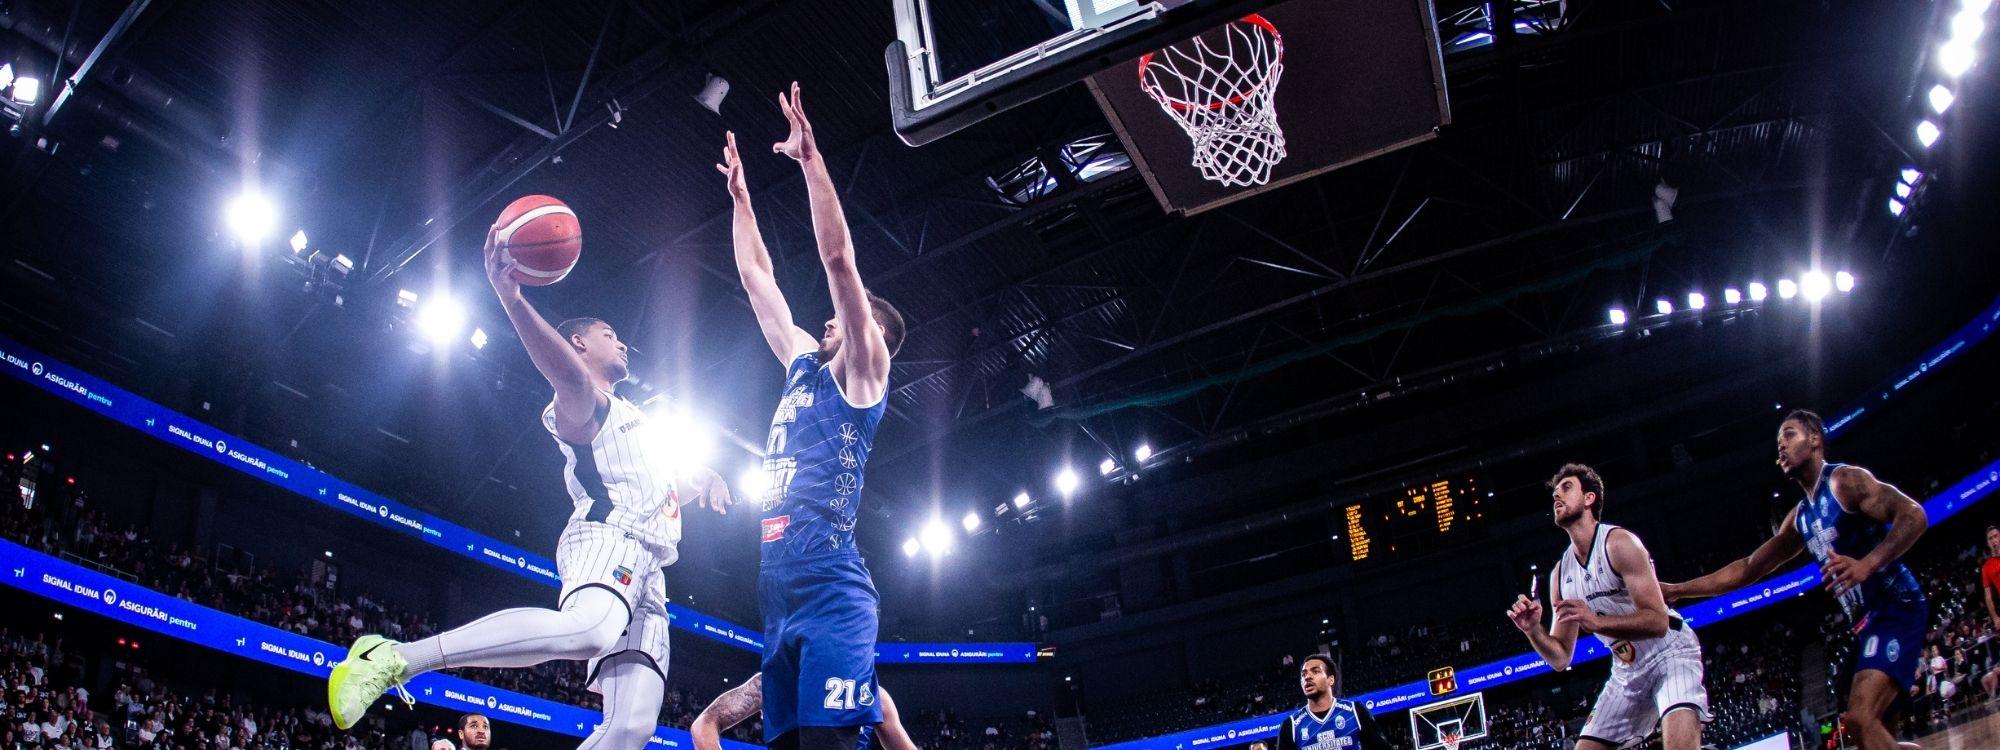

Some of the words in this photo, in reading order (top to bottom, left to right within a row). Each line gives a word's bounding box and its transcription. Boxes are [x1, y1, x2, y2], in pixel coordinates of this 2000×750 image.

[0, 351, 5, 359] L
[45, 373, 87, 395] ASIGURĂRI
[88, 392, 112, 406] pentru
[228, 450, 266, 469] ASIGURĂRI
[43, 574, 72, 590] SIGNAL
[75, 585, 99, 599] IDUNA
[119, 600, 167, 621] ASIGURĂRI
[169, 617, 196, 629] pentru
[261, 642, 287, 655] SIGNAL
[289, 650, 309, 662] IDUNA
[824, 677, 856, 710] 21
